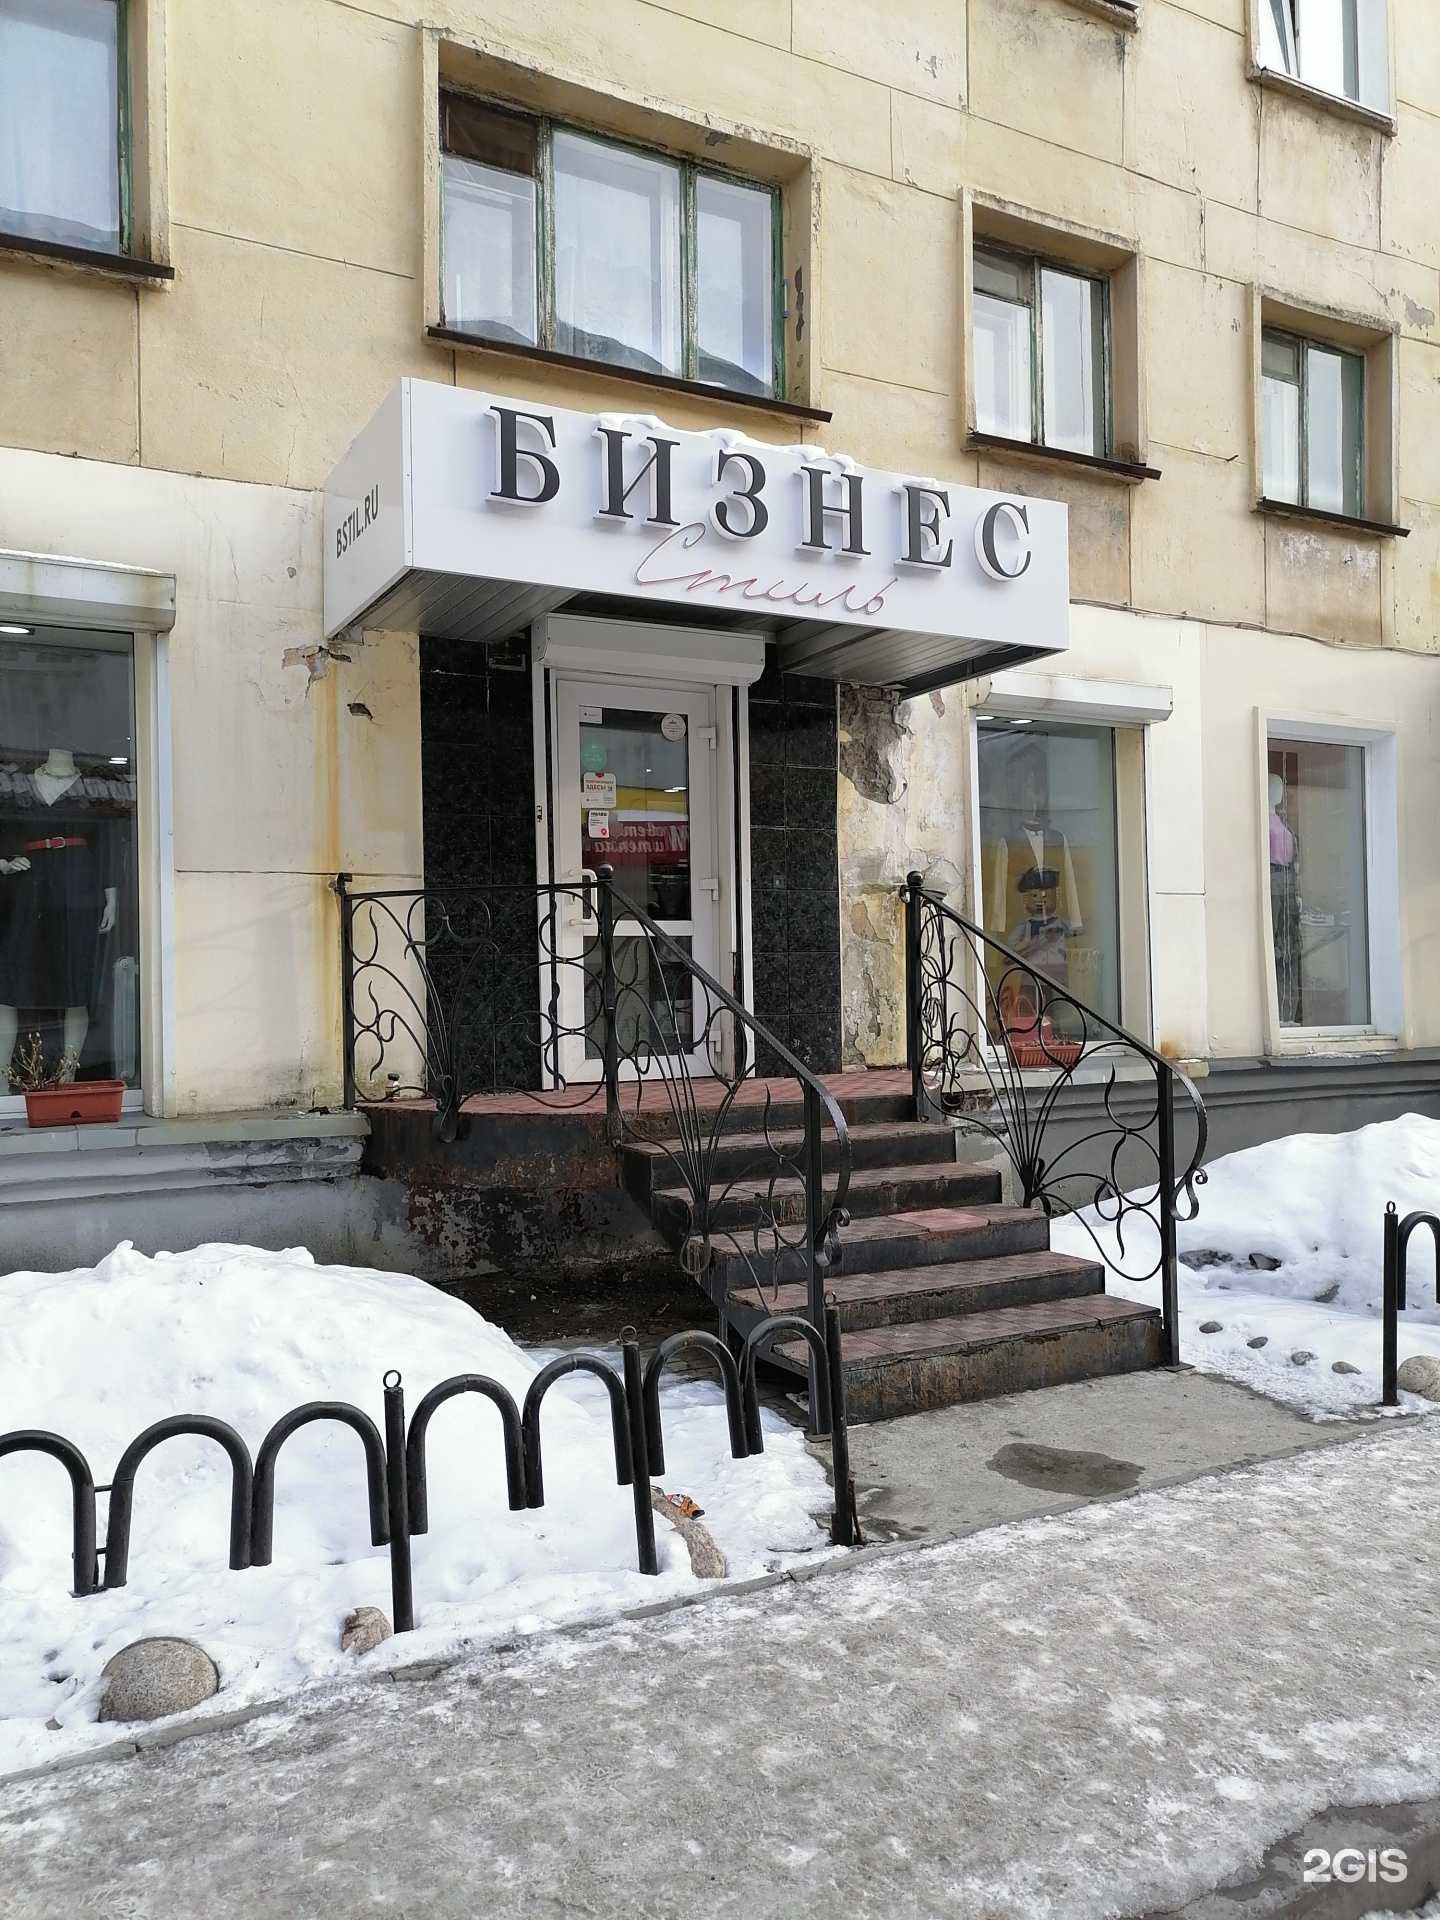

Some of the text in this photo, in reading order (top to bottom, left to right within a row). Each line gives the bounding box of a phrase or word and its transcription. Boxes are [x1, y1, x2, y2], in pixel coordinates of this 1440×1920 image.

[336, 484, 379, 559] BSTIL.RU
[489, 405, 1032, 579] БИЗНЕС
[634, 522, 899, 614] Стиль
